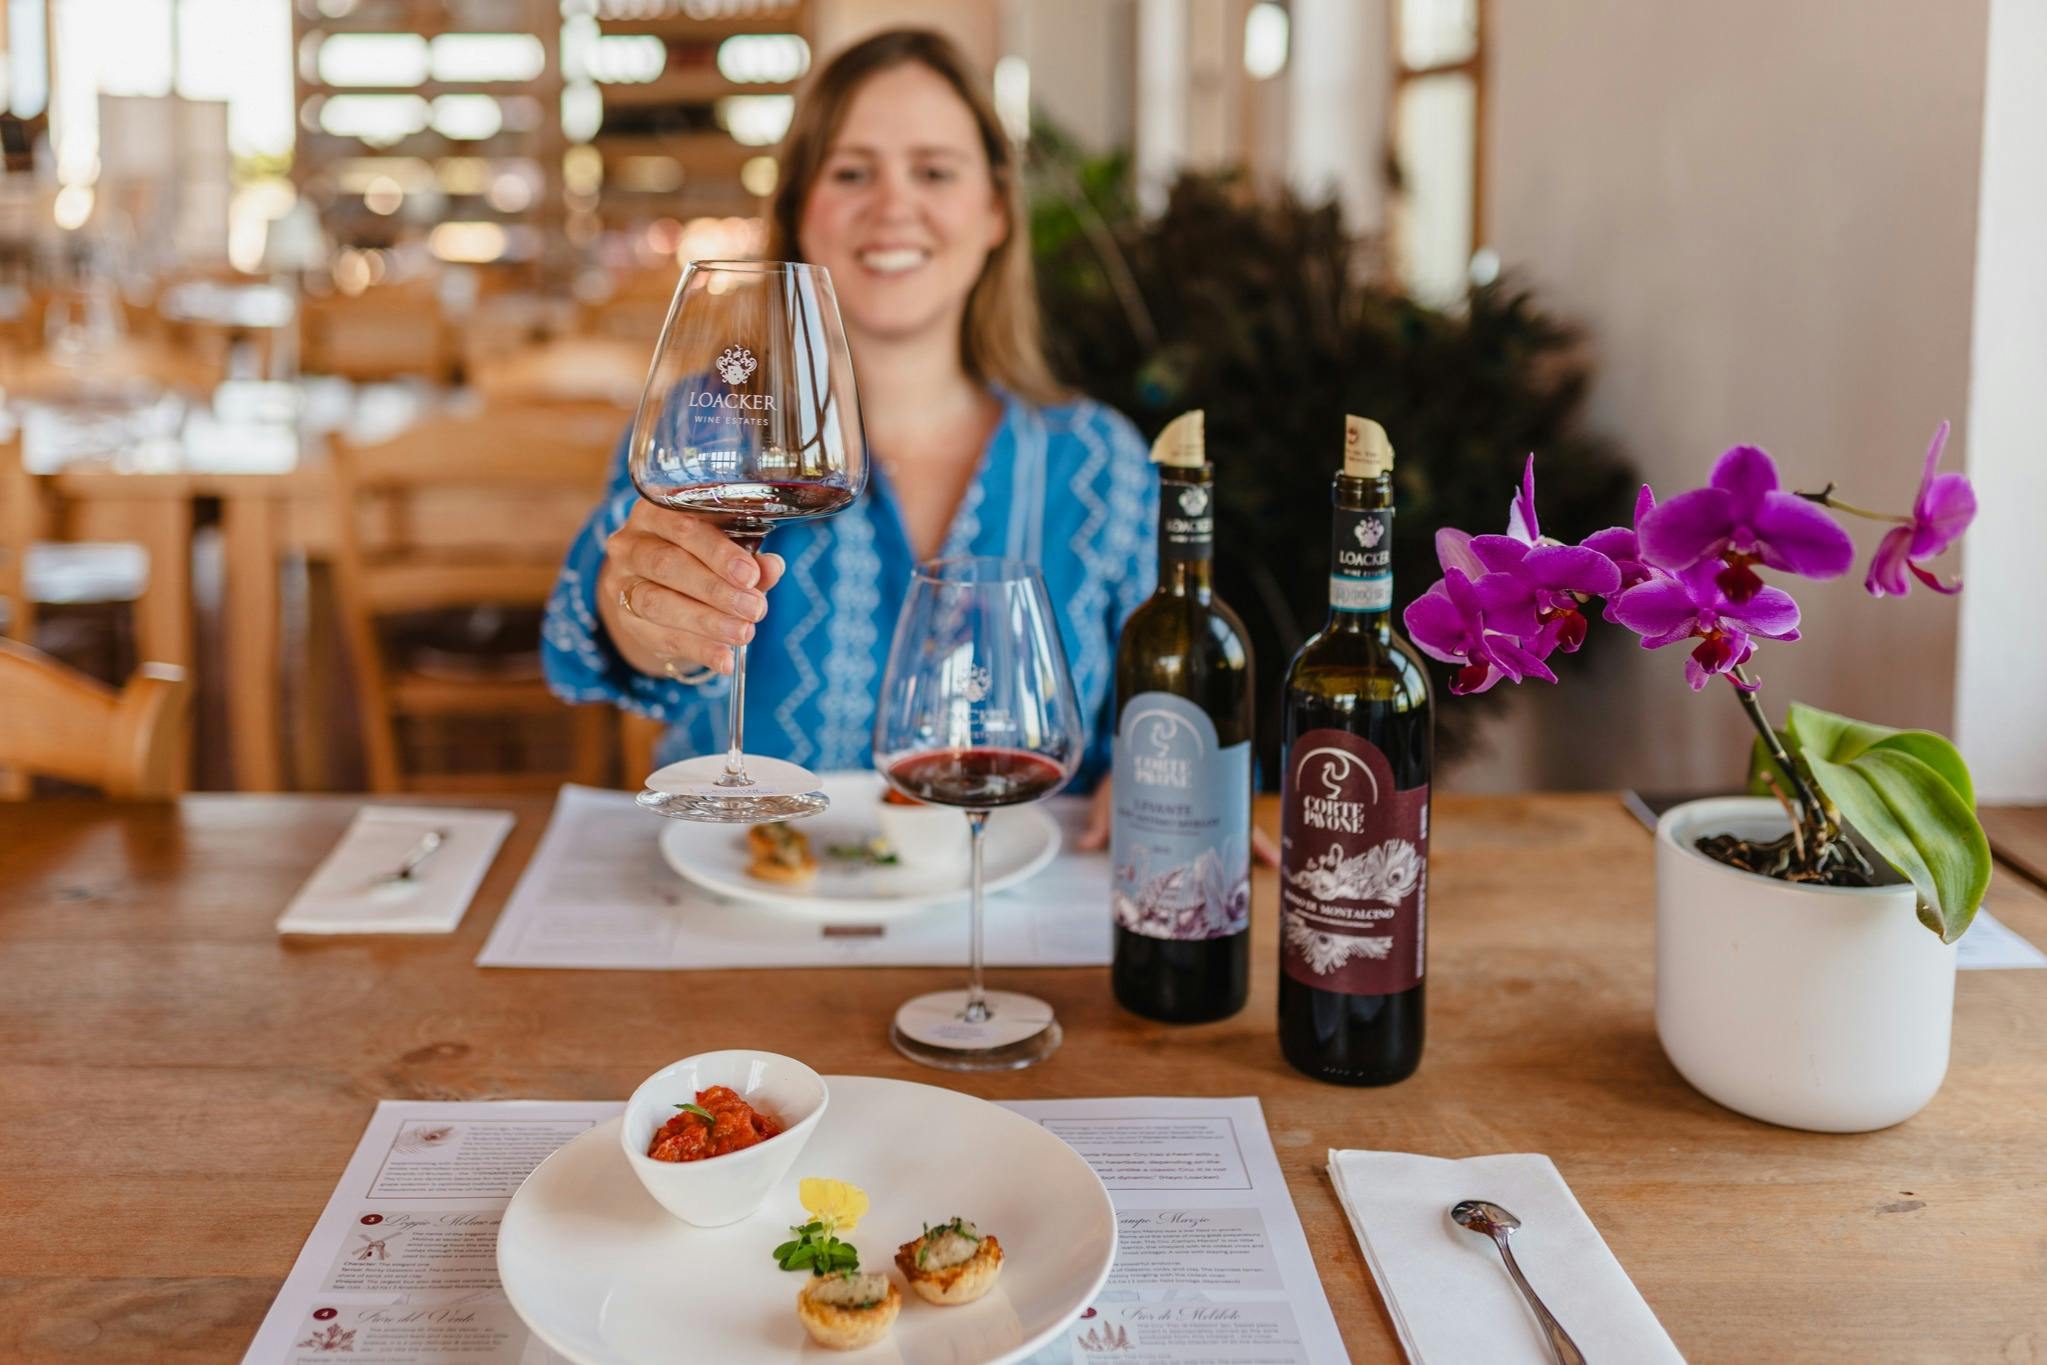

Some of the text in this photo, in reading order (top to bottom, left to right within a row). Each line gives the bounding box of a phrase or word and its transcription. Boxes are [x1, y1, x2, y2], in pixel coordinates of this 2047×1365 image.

[688, 391, 777, 411] LOACKER
[694, 415, 769, 426] WINE ESTATES
[1303, 795, 1364, 819] CORTE
[1320, 904, 1395, 920] MONTALCINO
